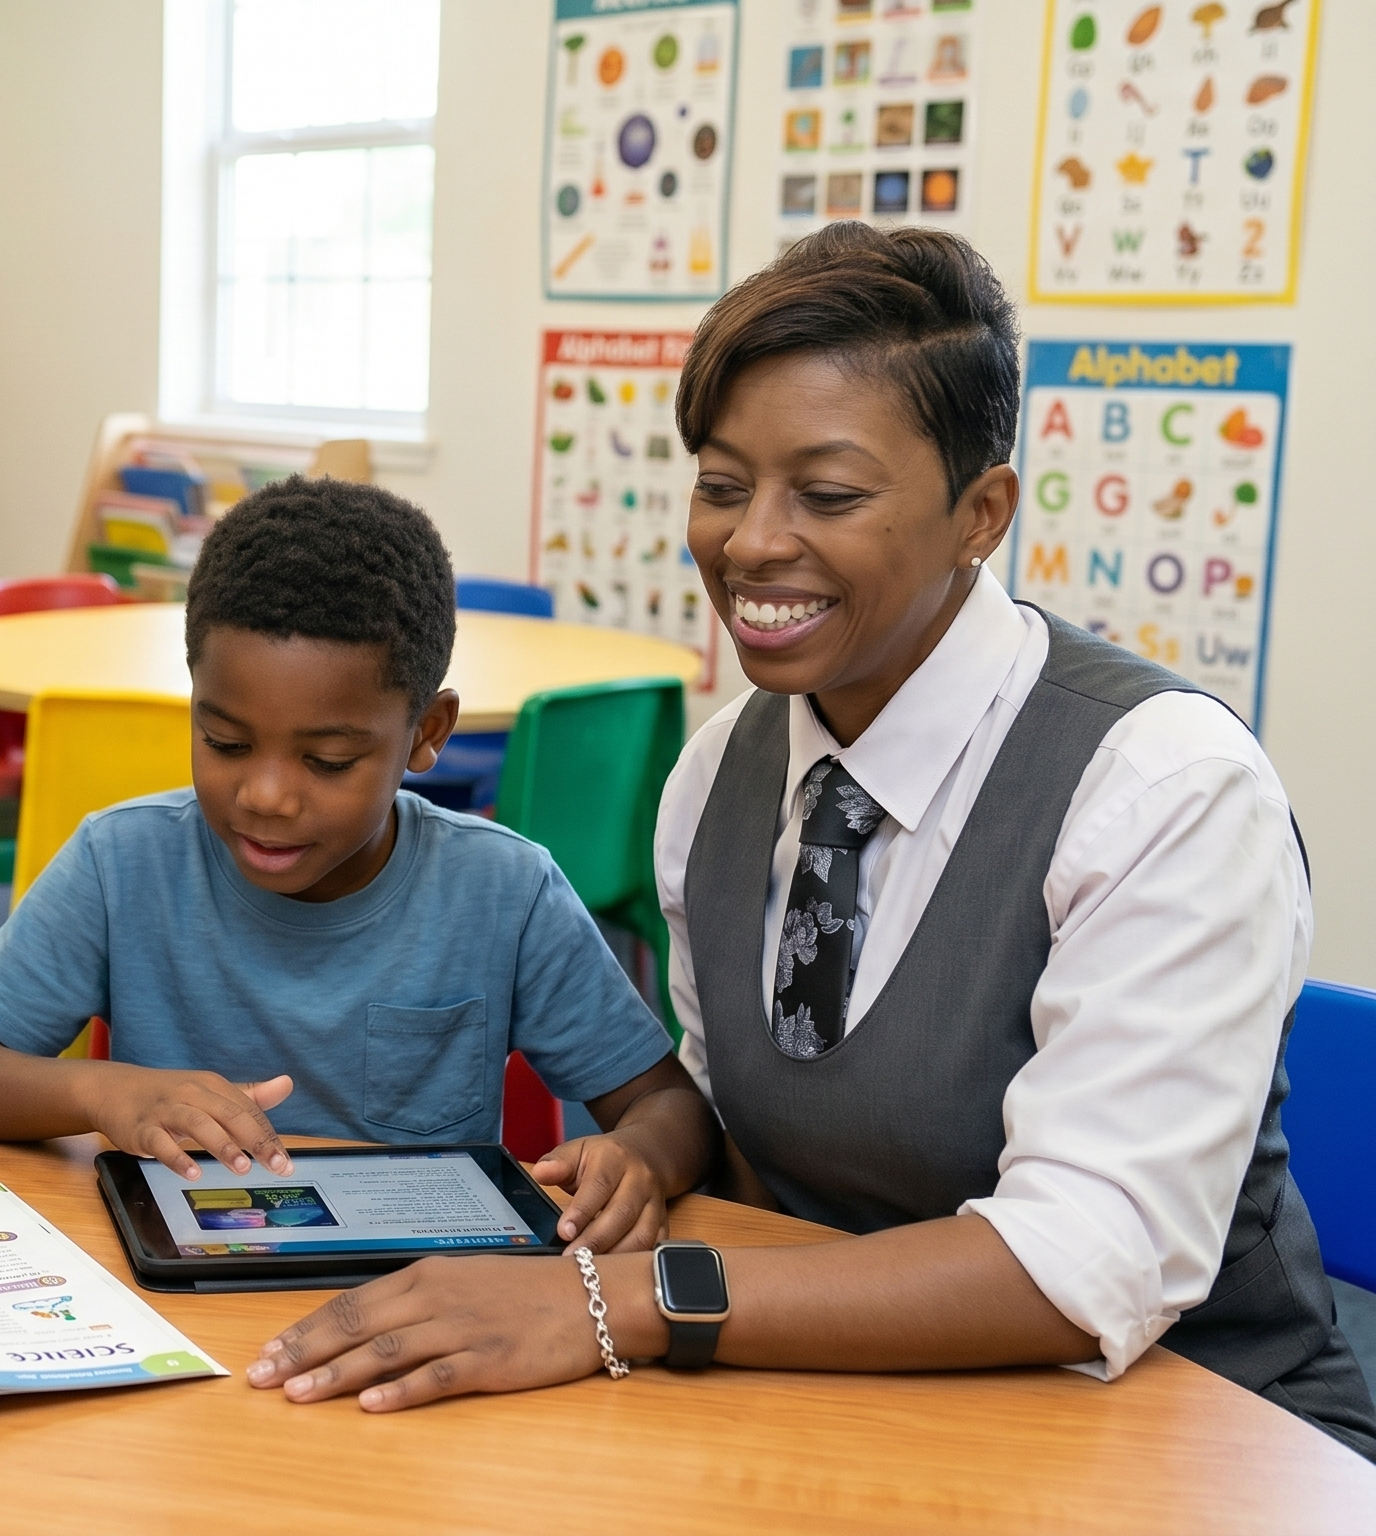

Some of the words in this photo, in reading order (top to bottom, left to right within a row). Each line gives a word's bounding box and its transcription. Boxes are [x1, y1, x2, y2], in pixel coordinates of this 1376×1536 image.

[1068, 345, 1241, 388] Alphabet
[1040, 400, 1073, 440] A
[1101, 400, 1131, 444] B
[1160, 402, 1195, 448] C
[1035, 470, 1071, 514] G
[1093, 473, 1130, 518] G
[1027, 543, 1070, 584] M
[1088, 549, 1123, 588] N
[1145, 553, 1186, 596] O
[1203, 557, 1233, 597] P
